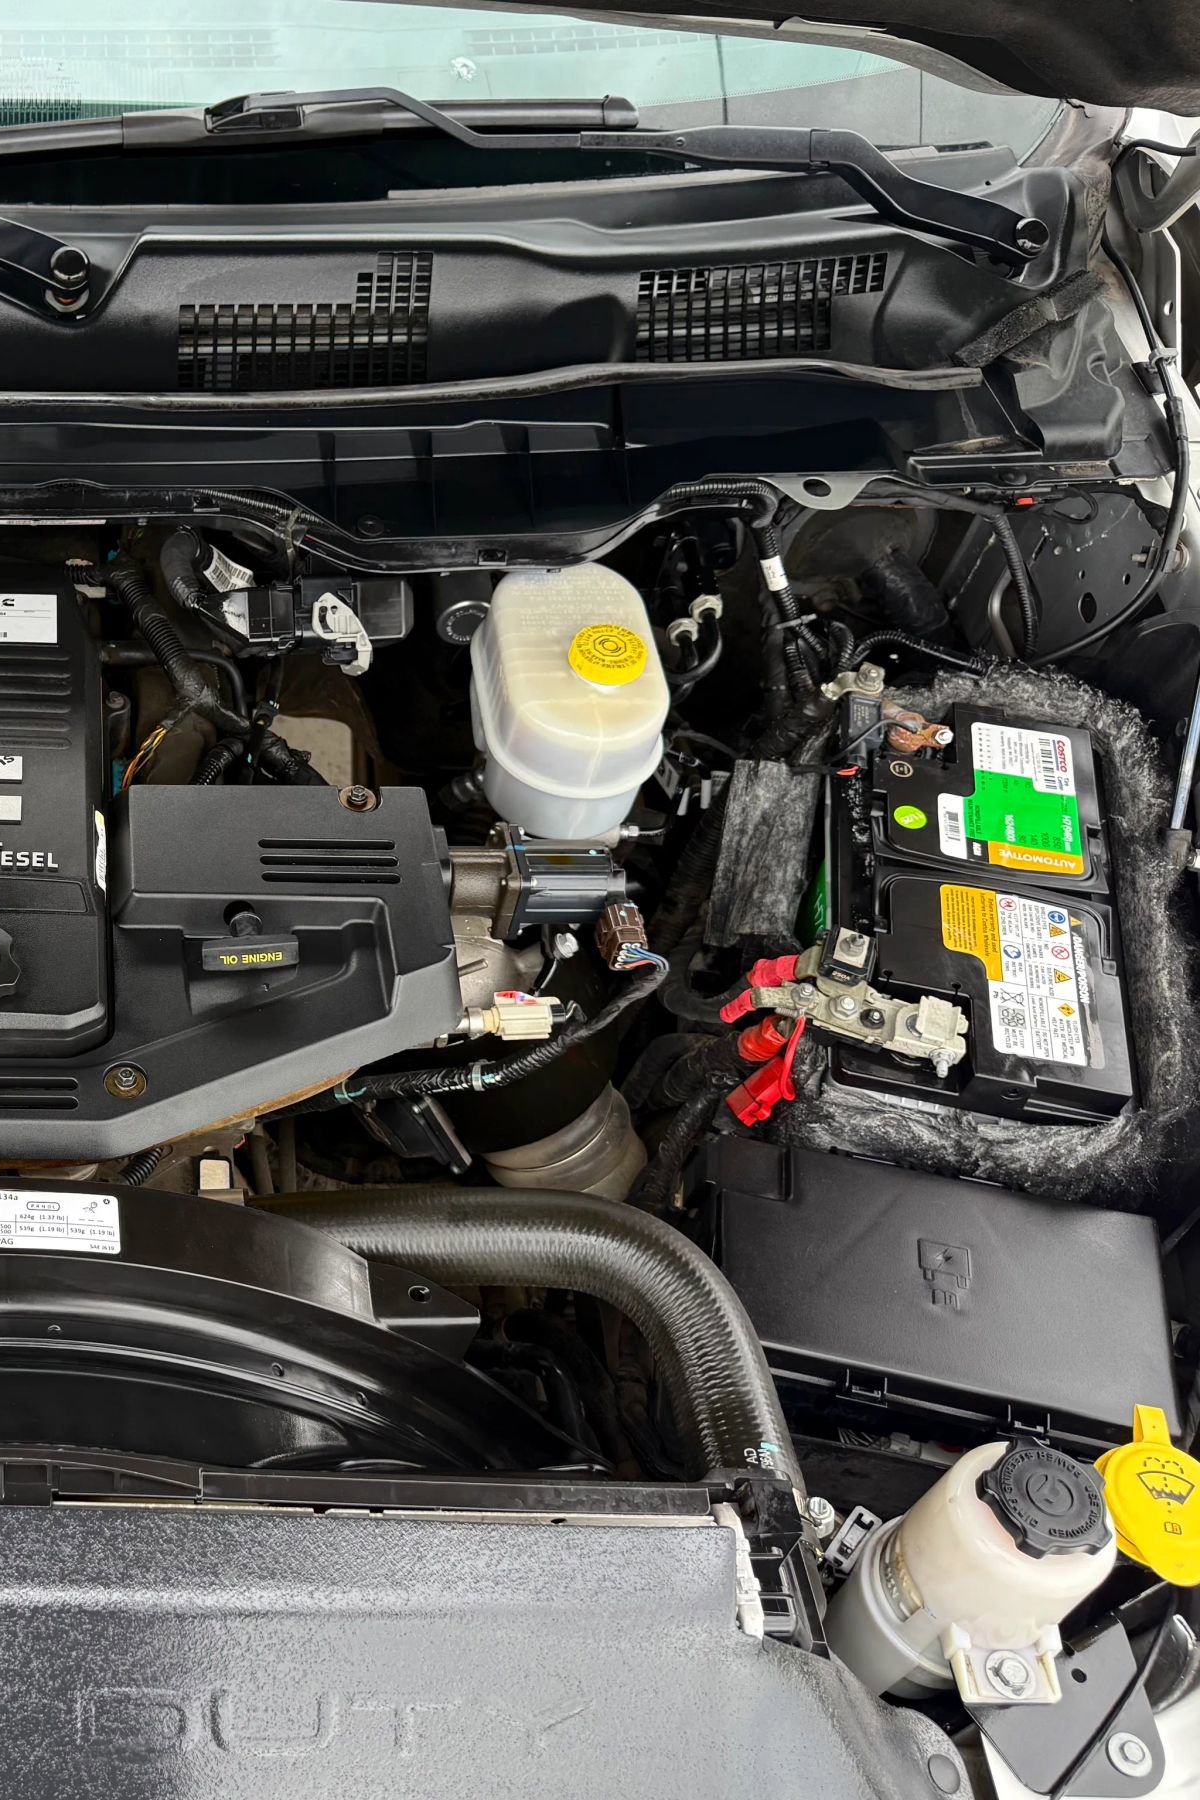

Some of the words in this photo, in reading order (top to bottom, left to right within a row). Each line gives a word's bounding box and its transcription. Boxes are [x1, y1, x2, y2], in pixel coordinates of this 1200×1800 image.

[1056, 739, 1068, 773] COSTCO
[1030, 833, 1039, 846] 140
[1040, 831, 1051, 848] 1000
[1052, 836, 1062, 850] 850
[998, 848, 1076, 870] AUTOMOTIVE
[219, 954, 238, 965] OIL
[241, 951, 283, 964] ENGINE
[1072, 934, 1090, 1004] DANGER/POISON
[19, 1225, 35, 1233] 539g
[70, 1227, 85, 1235] 539g
[1001, 1451, 1034, 1494] STEERING
[1048, 1509, 1100, 1538] APPROVED
[76, 1683, 596, 1760] DUTY
